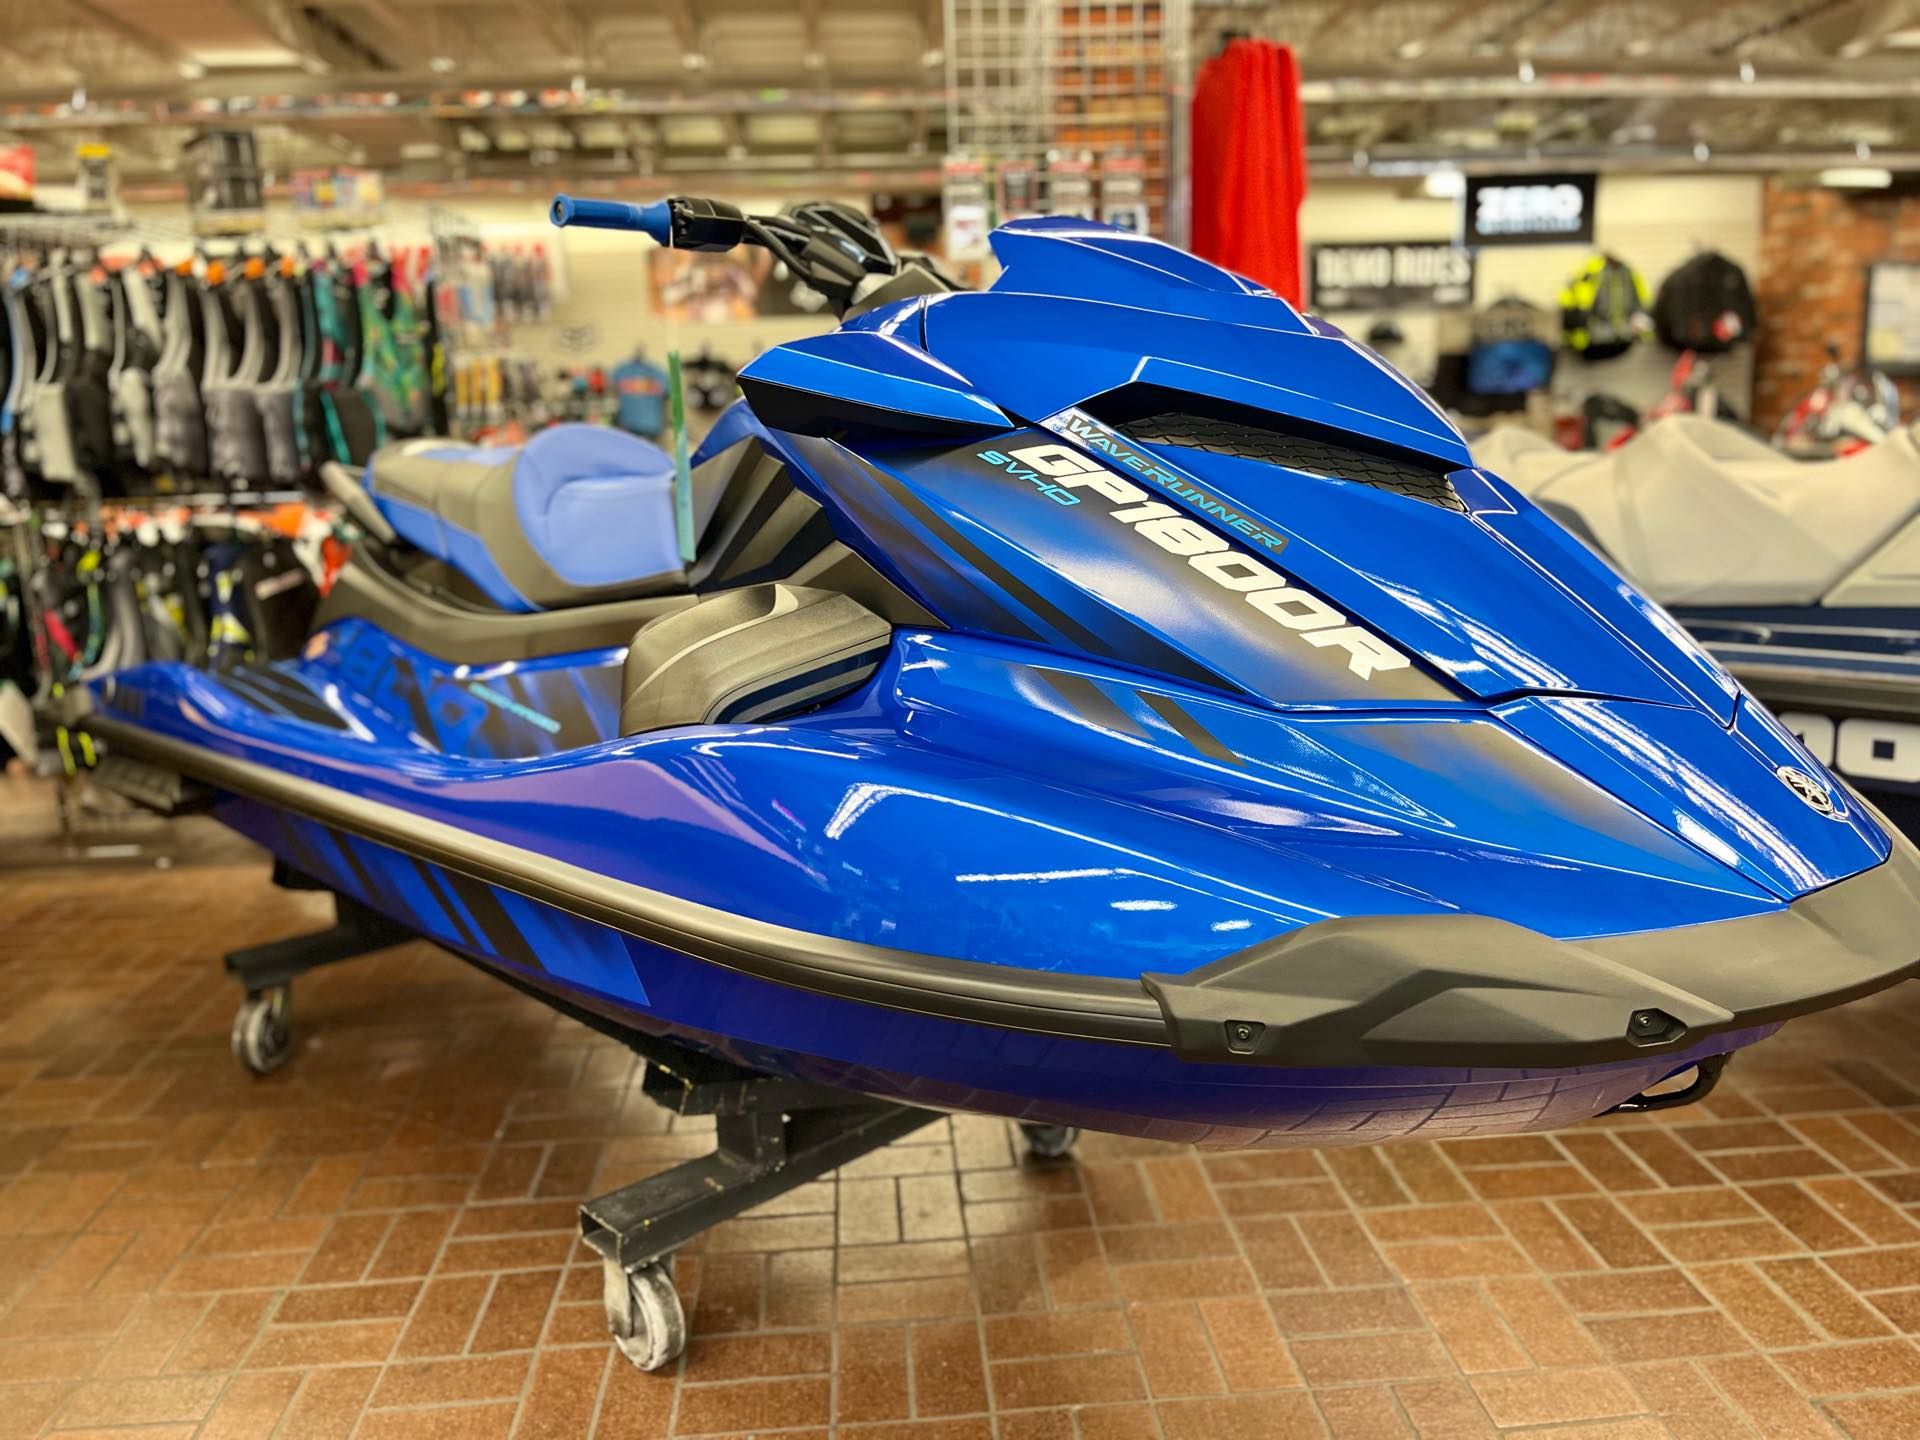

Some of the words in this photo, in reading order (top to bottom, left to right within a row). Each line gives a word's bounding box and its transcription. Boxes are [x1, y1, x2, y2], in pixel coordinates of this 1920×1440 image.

[976, 450, 1081, 506] SVHO
[1068, 417, 1282, 548] WAVERUNNER
[1008, 444, 1411, 681] GP1800R
